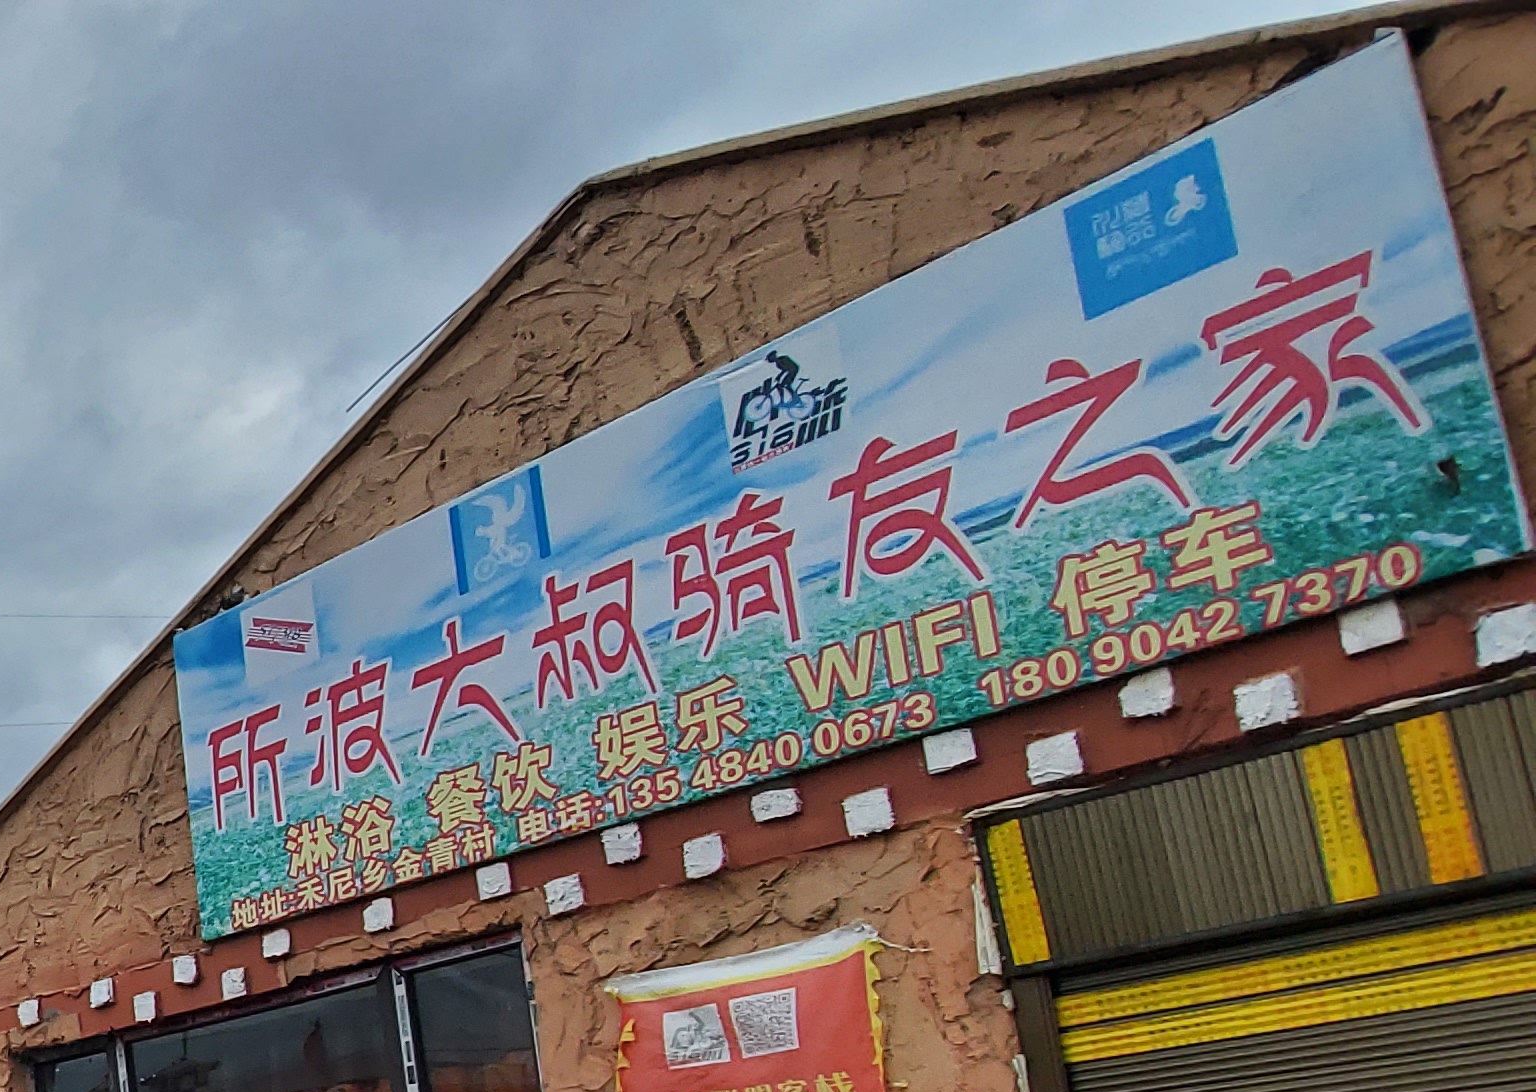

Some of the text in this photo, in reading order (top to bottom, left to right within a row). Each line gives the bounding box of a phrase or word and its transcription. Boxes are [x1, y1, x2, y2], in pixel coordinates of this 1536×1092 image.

[208, 250, 1428, 832] 所波大叔骑友之家
[285, 500, 1273, 879] 淋浴 餐饮 娱乐 WIFI 停车
[691, 732, 803, 791] 4840
[812, 693, 935, 757] 0673
[978, 649, 1079, 707] 180
[1089, 599, 1244, 675] 9042
[1251, 542, 1423, 627] 7370
